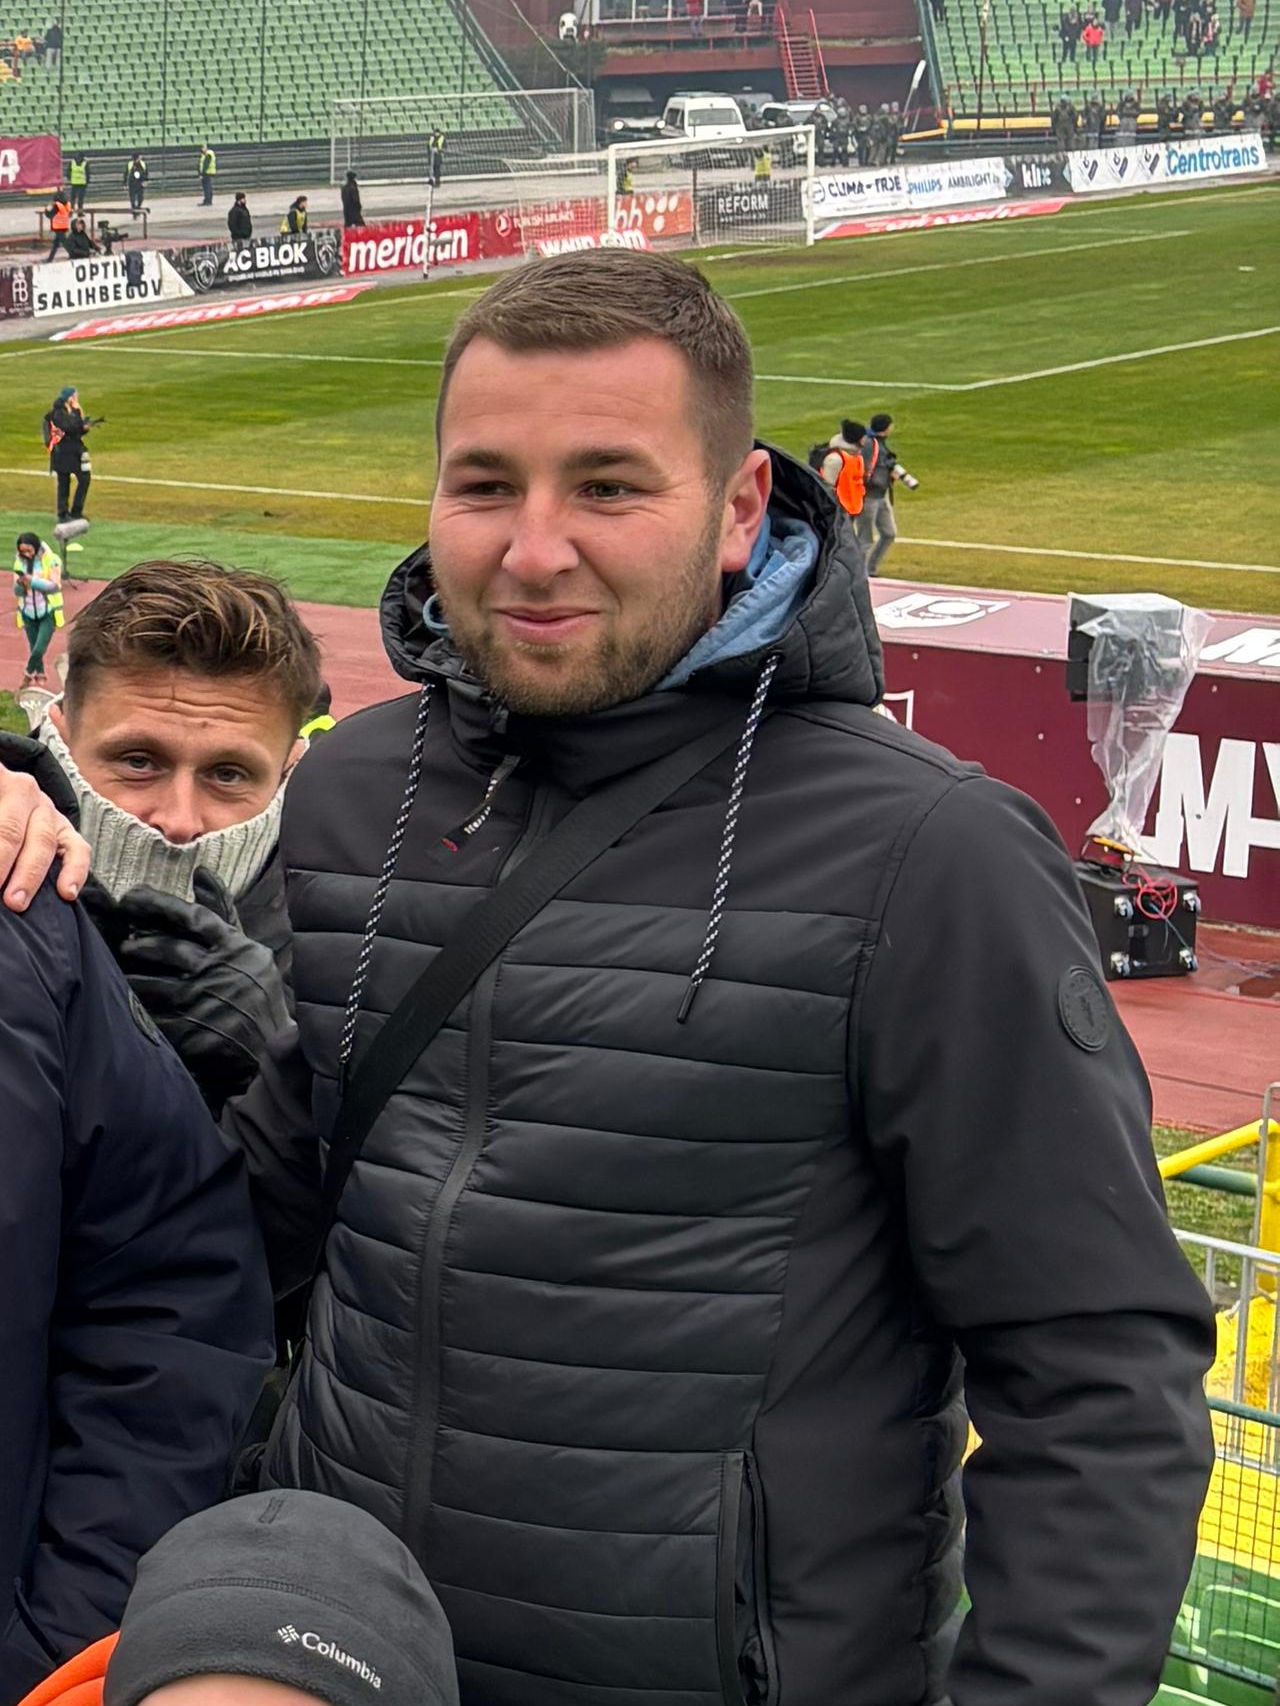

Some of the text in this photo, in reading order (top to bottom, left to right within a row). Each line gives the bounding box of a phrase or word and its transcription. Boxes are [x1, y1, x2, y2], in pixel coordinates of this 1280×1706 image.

[1167, 144, 1260, 175] Centrotrans
[224, 249, 252, 274] AC
[256, 242, 308, 269] BLOK
[302, 1632, 382, 1690] Columbia
